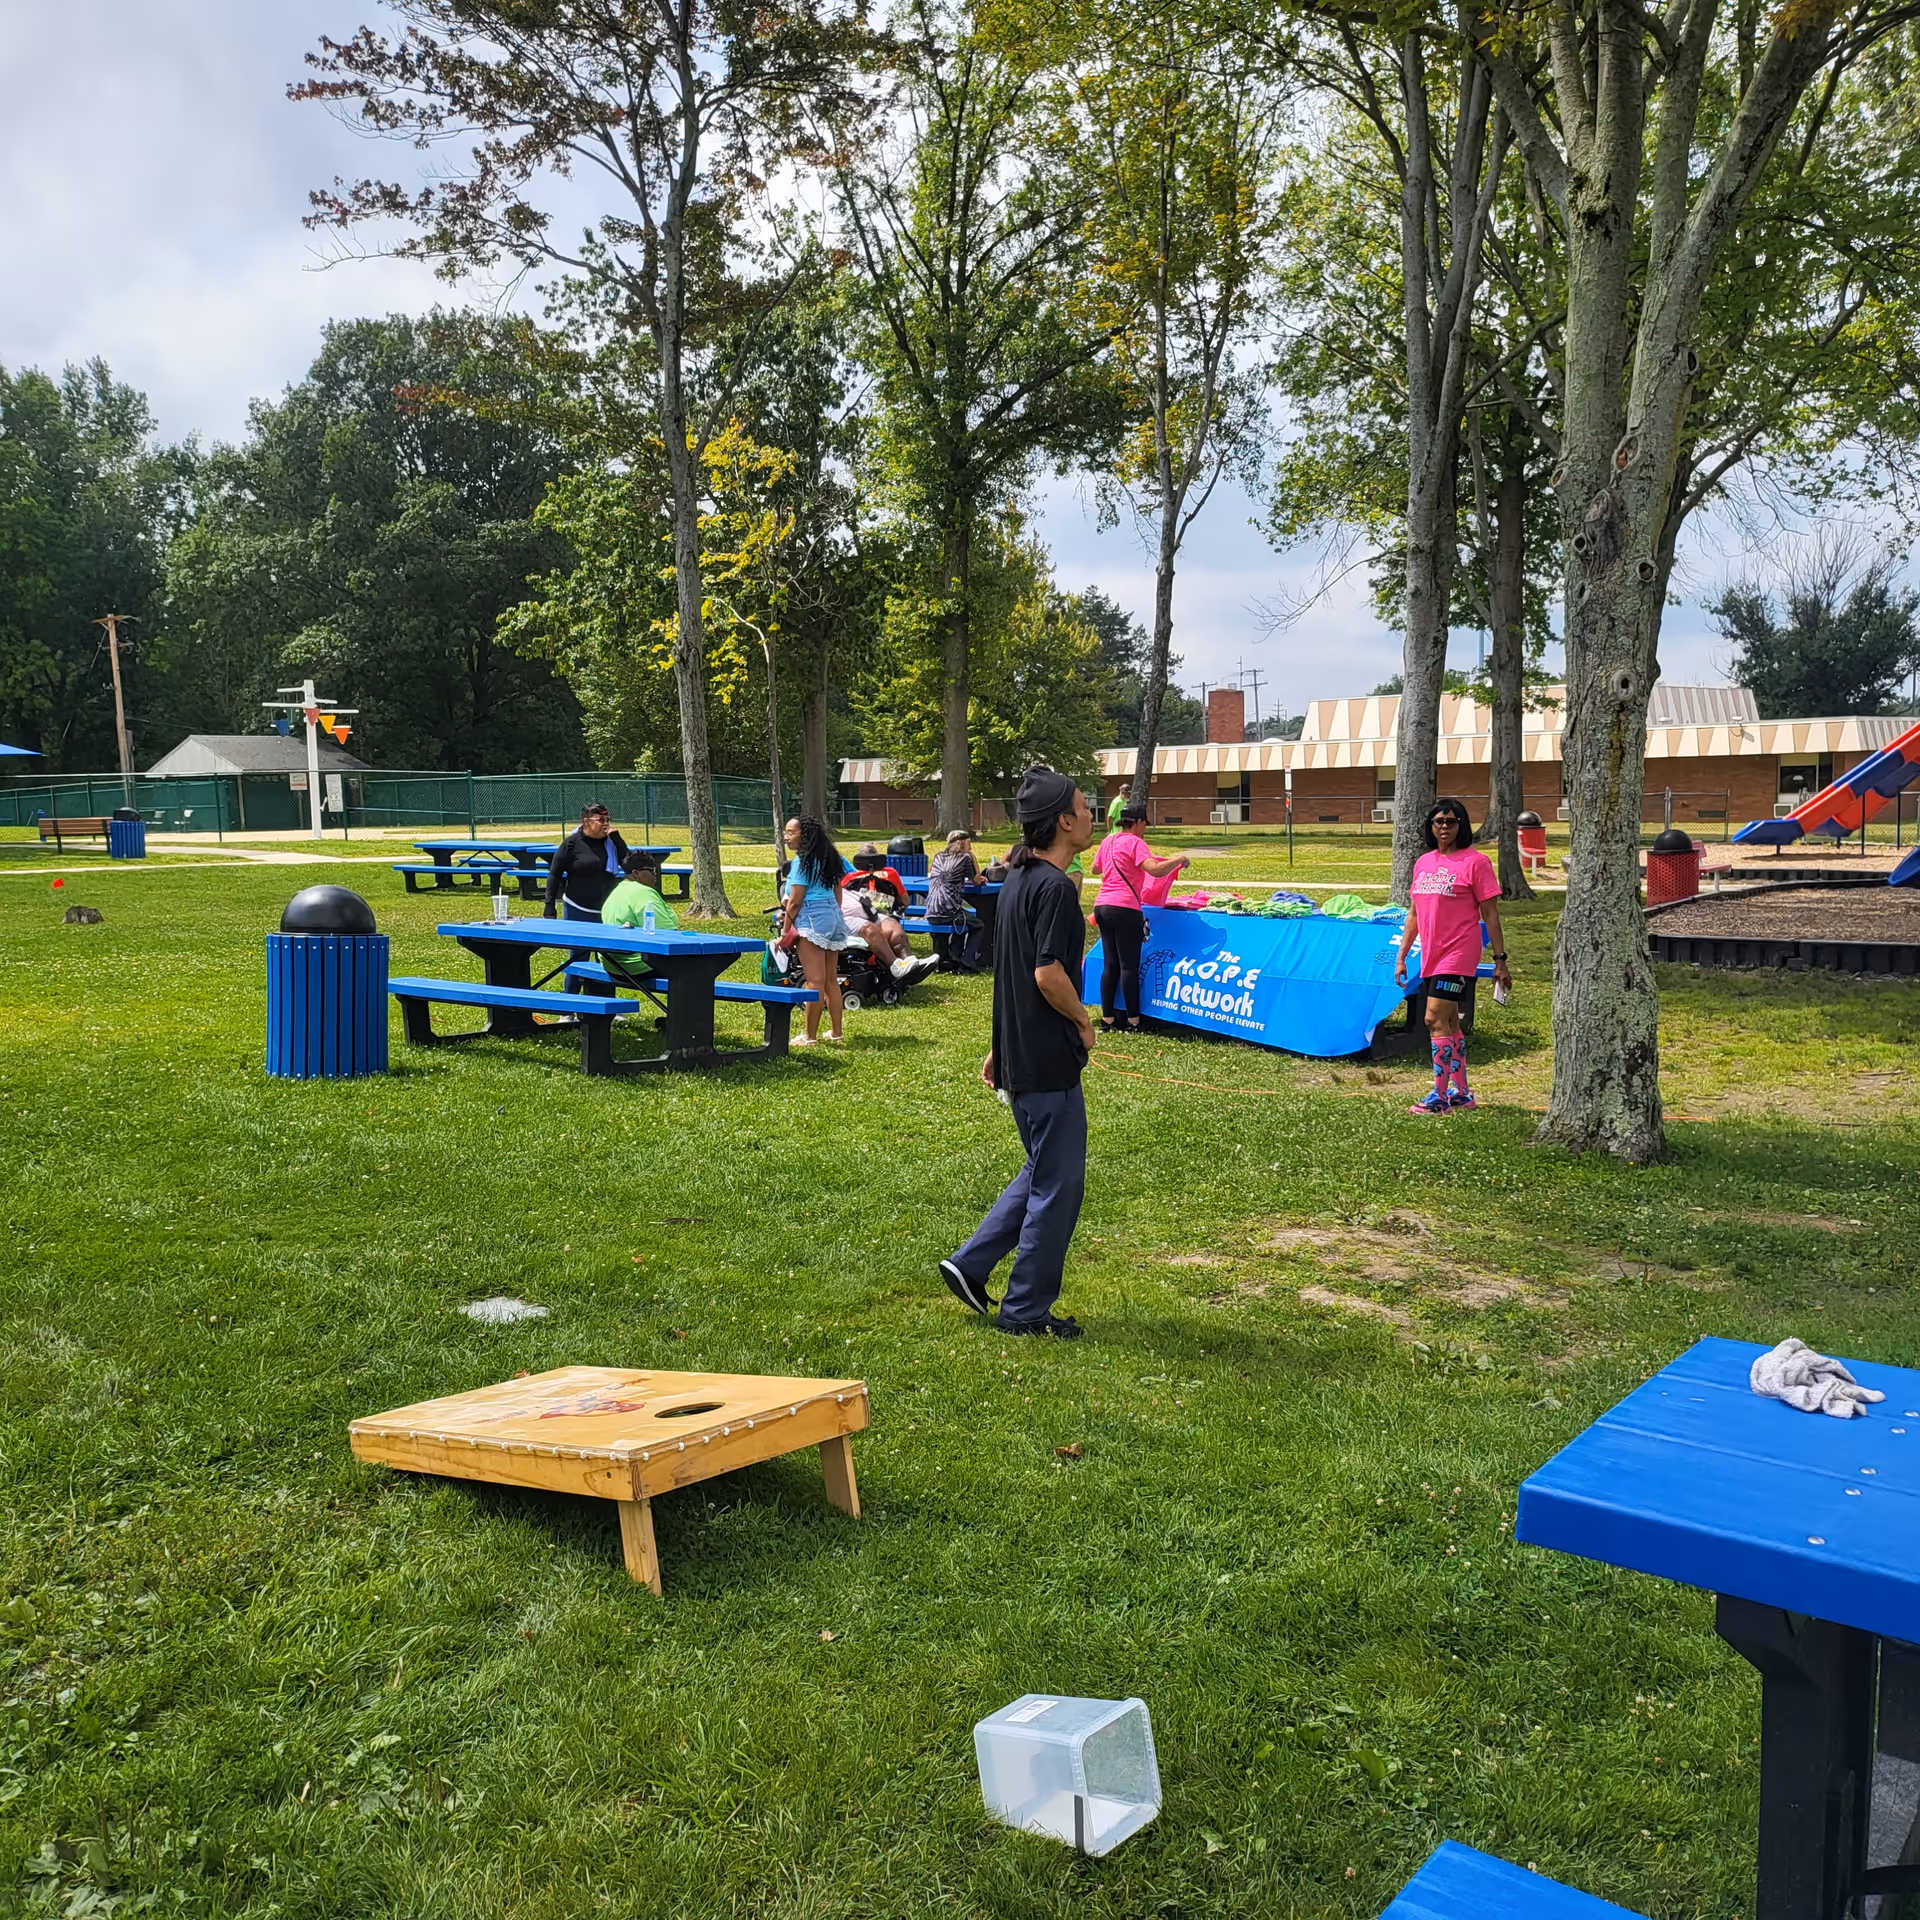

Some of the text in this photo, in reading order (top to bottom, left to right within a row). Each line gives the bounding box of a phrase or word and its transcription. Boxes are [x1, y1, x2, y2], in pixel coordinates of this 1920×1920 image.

[1173, 956, 1262, 990] H.O.P.E
[1216, 950, 1241, 963] The
[1165, 975, 1255, 1018] Network
[1151, 998, 1266, 1031] HELPING OTHER PEOPLE ELEVATE
